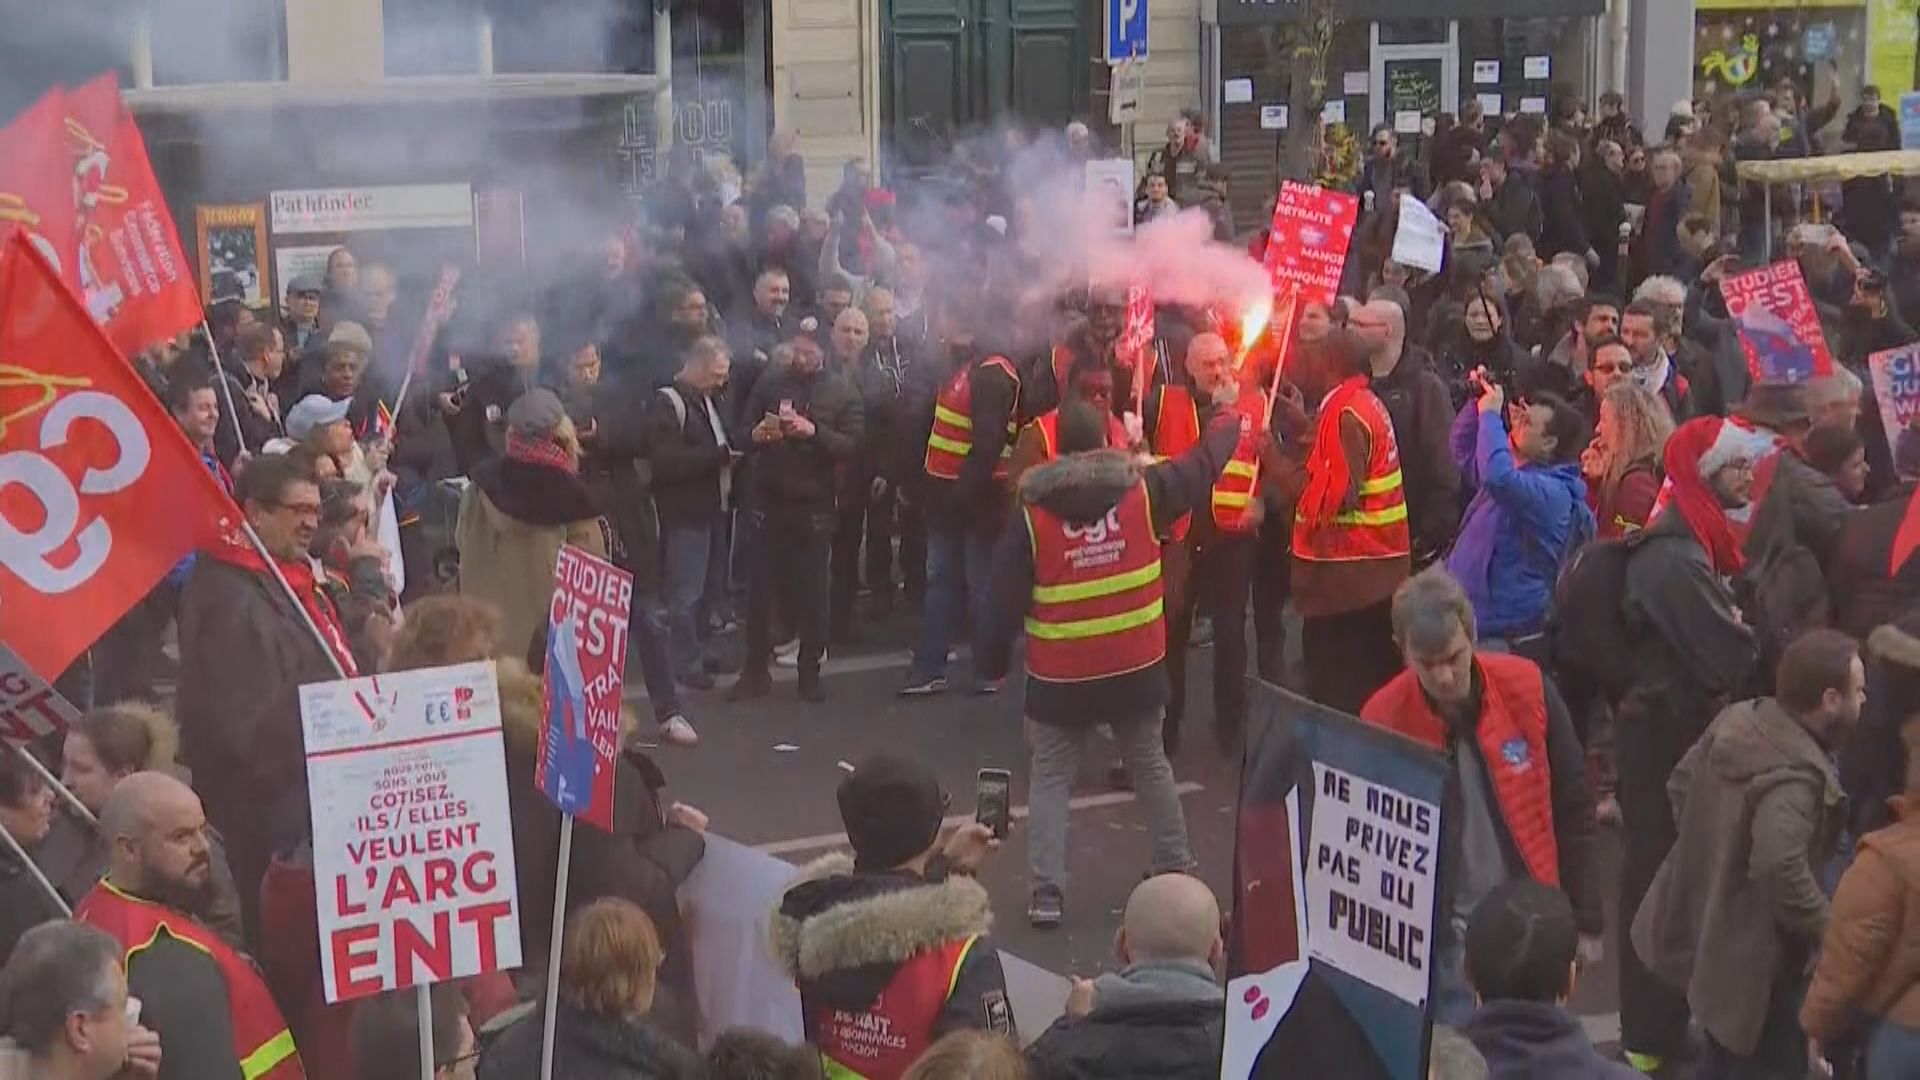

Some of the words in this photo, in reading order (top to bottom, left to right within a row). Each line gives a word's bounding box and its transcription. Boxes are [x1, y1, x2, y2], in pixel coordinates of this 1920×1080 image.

[1120, 0, 1138, 41] P
[274, 190, 372, 213] Pathfinder
[1281, 192, 1296, 205] TA
[1282, 180, 1322, 198] SAUVE
[550, 587, 628, 665] C'EST
[584, 663, 621, 708] TRA
[587, 706, 619, 733] VAIL
[416, 770, 447, 784] VOUS
[358, 815, 389, 833] ILS
[409, 801, 468, 823] ELLES
[1323, 770, 1351, 803] NE
[1367, 786, 1431, 836] NOUS
[347, 822, 480, 864] VEULENT
[1346, 816, 1430, 876] PRIVEZ
[336, 850, 498, 917] L'ARG
[1318, 844, 1360, 885] PAS
[1329, 889, 1424, 970] PUBLIC
[331, 900, 512, 1001] ENT
